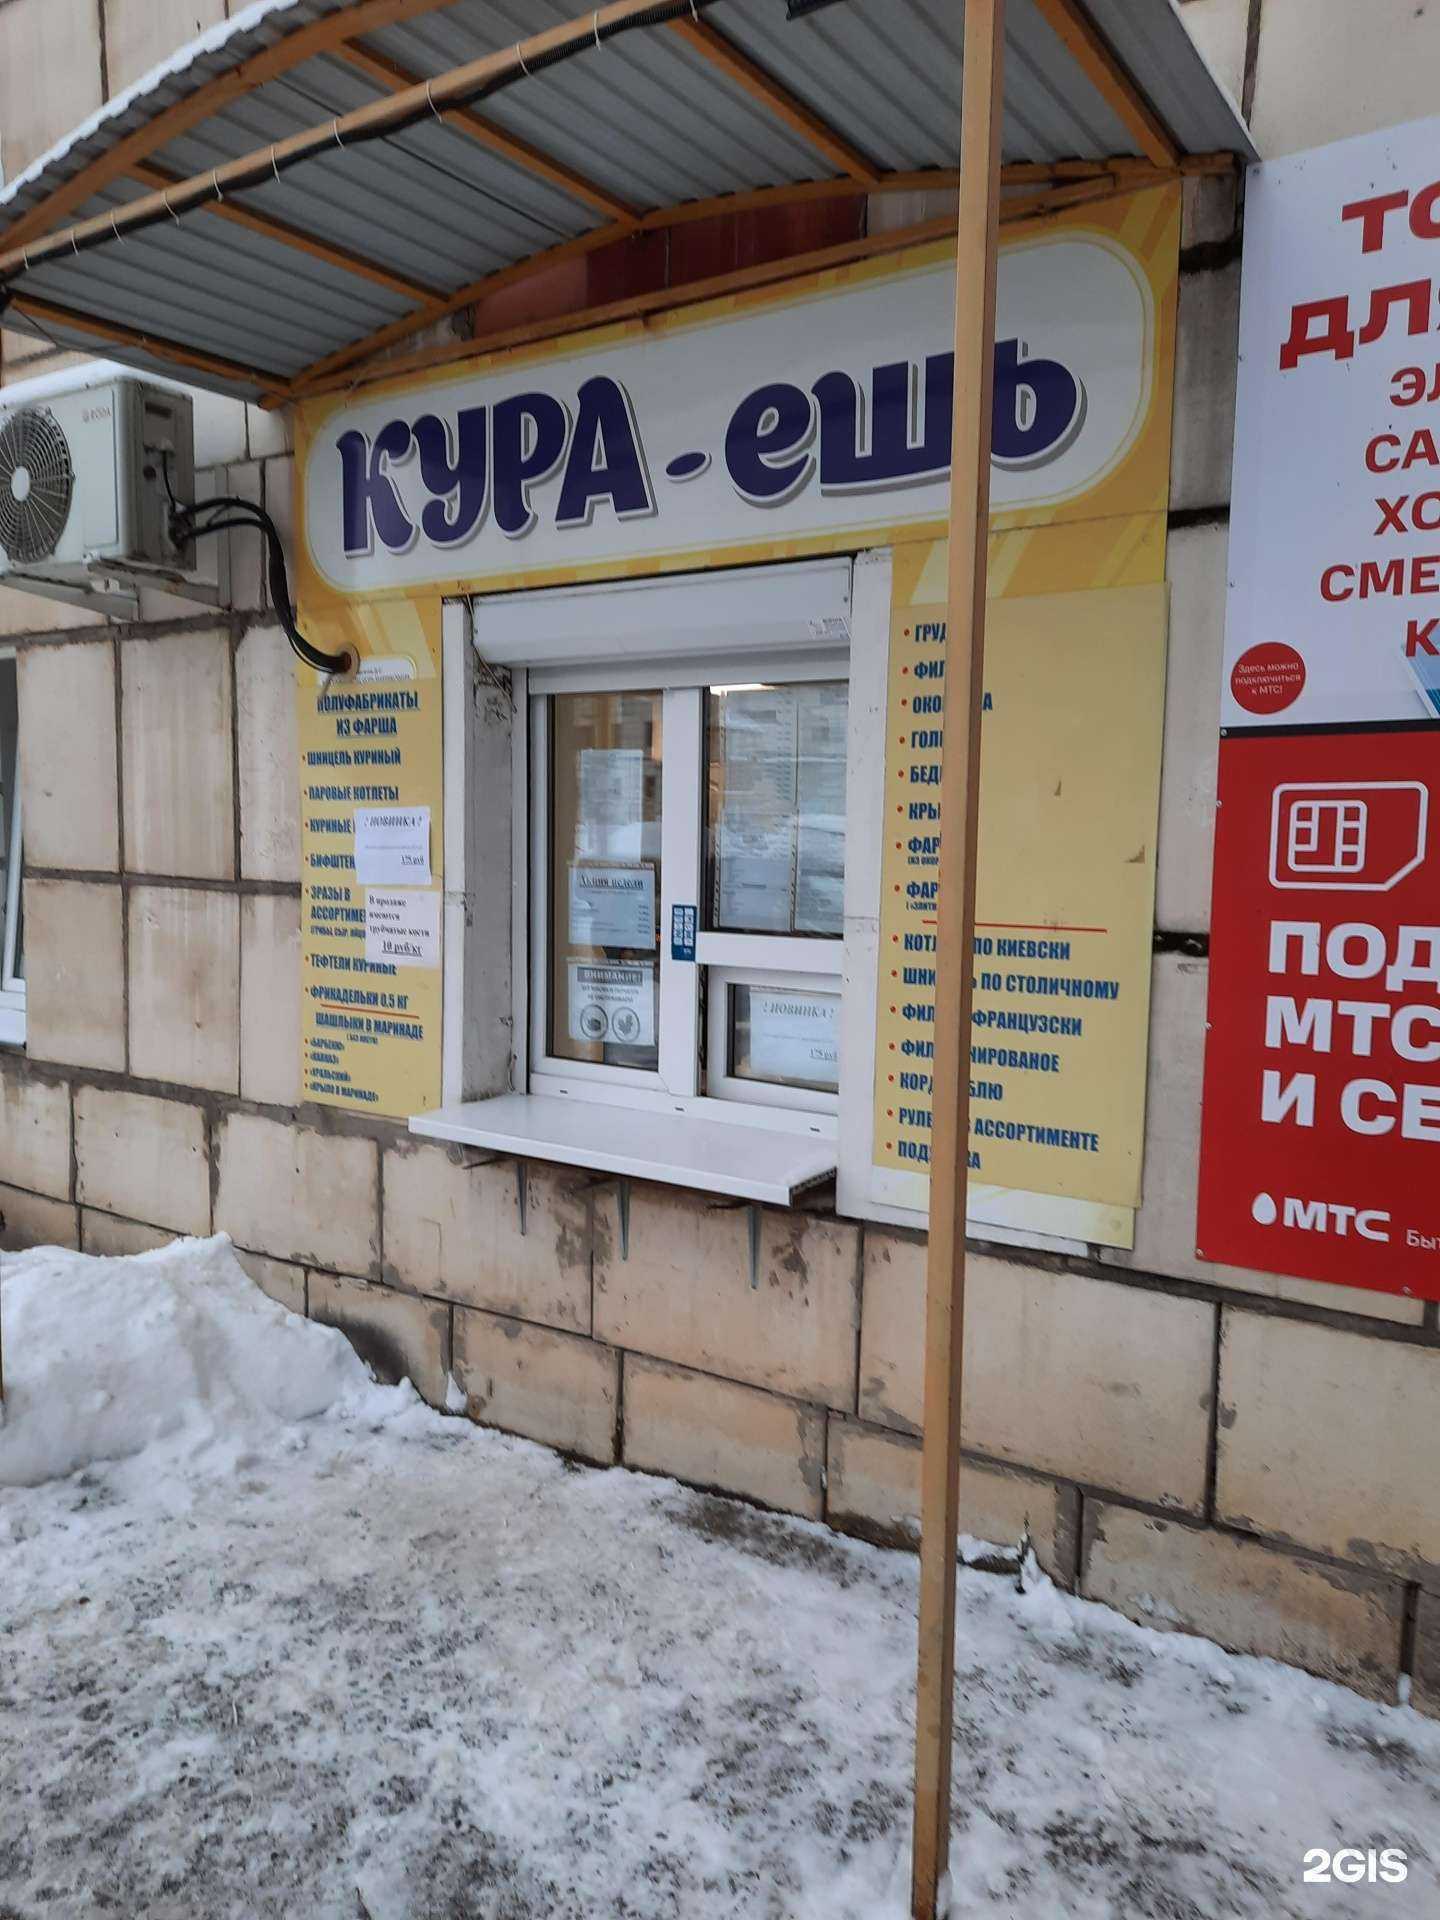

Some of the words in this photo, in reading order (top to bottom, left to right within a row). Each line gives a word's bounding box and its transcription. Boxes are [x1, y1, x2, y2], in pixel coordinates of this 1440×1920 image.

[1280, 278, 1440, 371] ДЛ
[1365, 428, 1440, 473] СА
[337, 374, 657, 559] КУРА
[1320, 555, 1440, 602] СМЕ
[1239, 664, 1266, 674] Здесь
[1267, 663, 1299, 673] можно
[1235, 674, 1301, 686] подключиться
[317, 691, 419, 713] ПОЛУФАБРИКАТЫ
[336, 718, 351, 735] ИЗ
[353, 716, 398, 735] ФАРША
[911, 730, 943, 749] ГОЛ
[307, 750, 352, 768] ШНИЦЕЛЬ
[353, 747, 401, 766] КУРИНЫЙ
[910, 764, 942, 786] БЕД
[309, 785, 352, 801] ПАРОВЫЕ
[353, 785, 399, 801] КОТЛЕТЫ
[909, 802, 941, 820] КРЫ
[310, 818, 352, 834] КУРИНЫЕ
[908, 836, 942, 855] ФАР
[310, 852, 356, 870] БИФШТЕК
[311, 885, 343, 901] ЗРАЗЫ
[344, 887, 352, 901] В
[906, 881, 938, 898] ФАР
[311, 905, 367, 923] АССОРТИМЕ
[904, 933, 937, 952] КОТ
[996, 937, 1071, 960] КИЕВСКИ
[1268, 919, 1440, 994] ПОД
[310, 953, 351, 971] ТЕФТЕЛИ
[353, 957, 397, 976] КУРИНЫЕ
[981, 972, 1002, 992] ПО
[1005, 976, 1120, 1000] СТОЛИЧНОМУ
[310, 985, 379, 1006] ФРИКАДЕЛЬКИ
[397, 994, 409, 1010] КГ
[902, 1003, 935, 1022] ФИЛ
[315, 1012, 364, 1032] ШАШЛЫКИ
[365, 1018, 372, 1032] В
[373, 1019, 424, 1040] МАРИНАДЕ
[1264, 994, 1440, 1063] МТС
[901, 1039, 934, 1059] ФИЛ
[900, 1071, 933, 1095] КОР
[1261, 1069, 1316, 1128] И
[1340, 1078, 1440, 1142] СЕ
[899, 1106, 933, 1128] РУЛЕ
[974, 1117, 1100, 1152] АССОРТИМЕНТЕ
[1283, 1196, 1391, 1242] МТС
[1407, 1229, 1440, 1250] Бы
